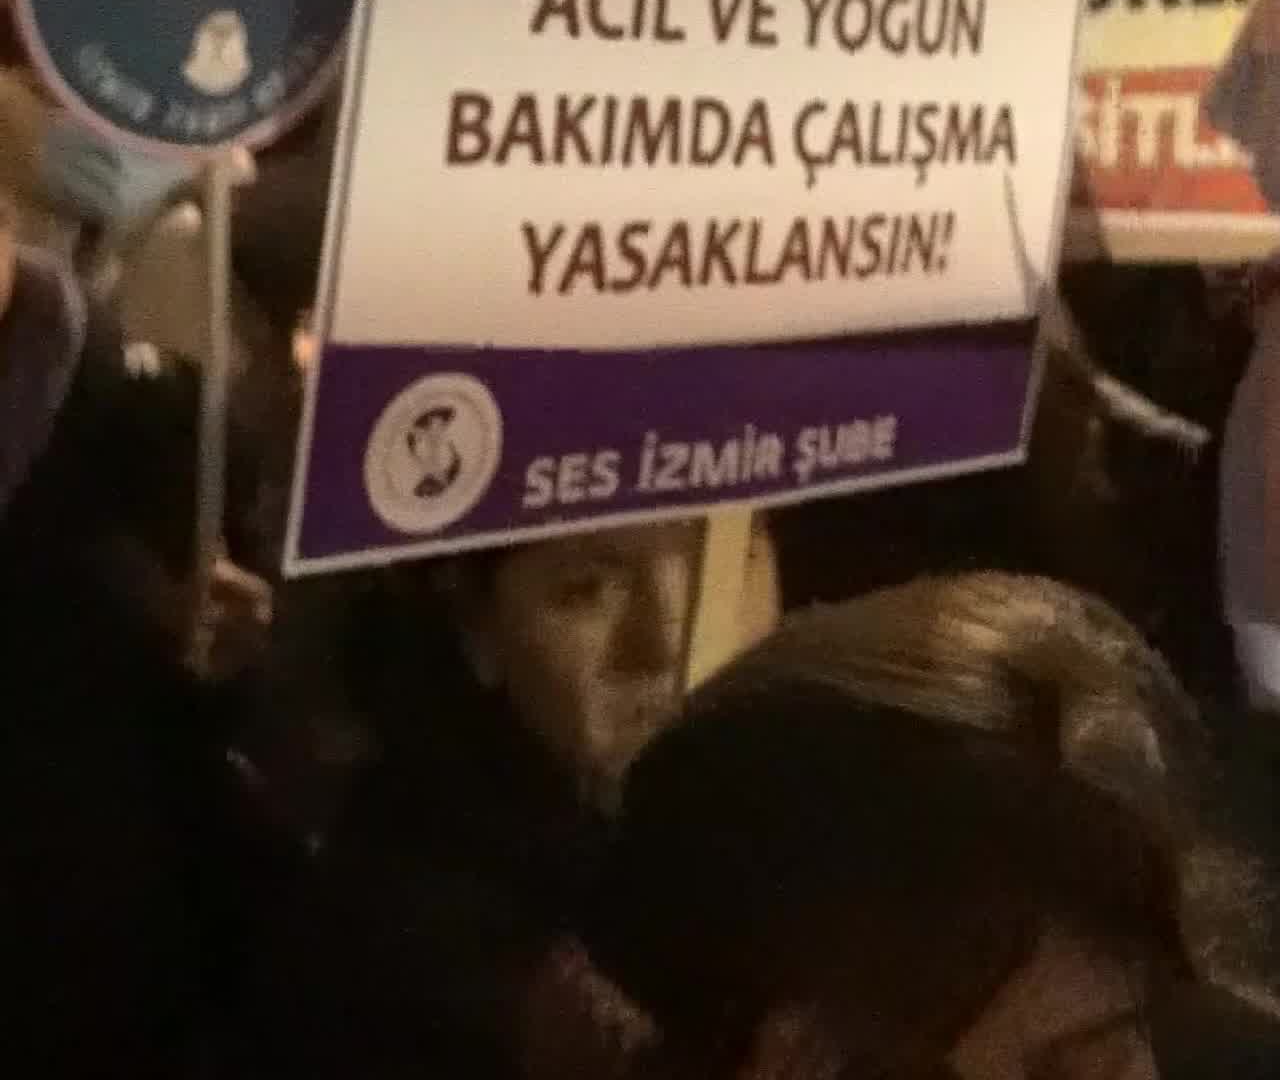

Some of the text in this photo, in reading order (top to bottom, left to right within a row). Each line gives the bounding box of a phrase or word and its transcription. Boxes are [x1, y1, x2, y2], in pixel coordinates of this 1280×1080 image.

[445, 90, 1018, 189] BAKIMDA ÇALIŞMA
[519, 212, 957, 297] YASAKLANSIN!
[521, 450, 621, 508] SES
[638, 424, 784, 491] İZMİR
